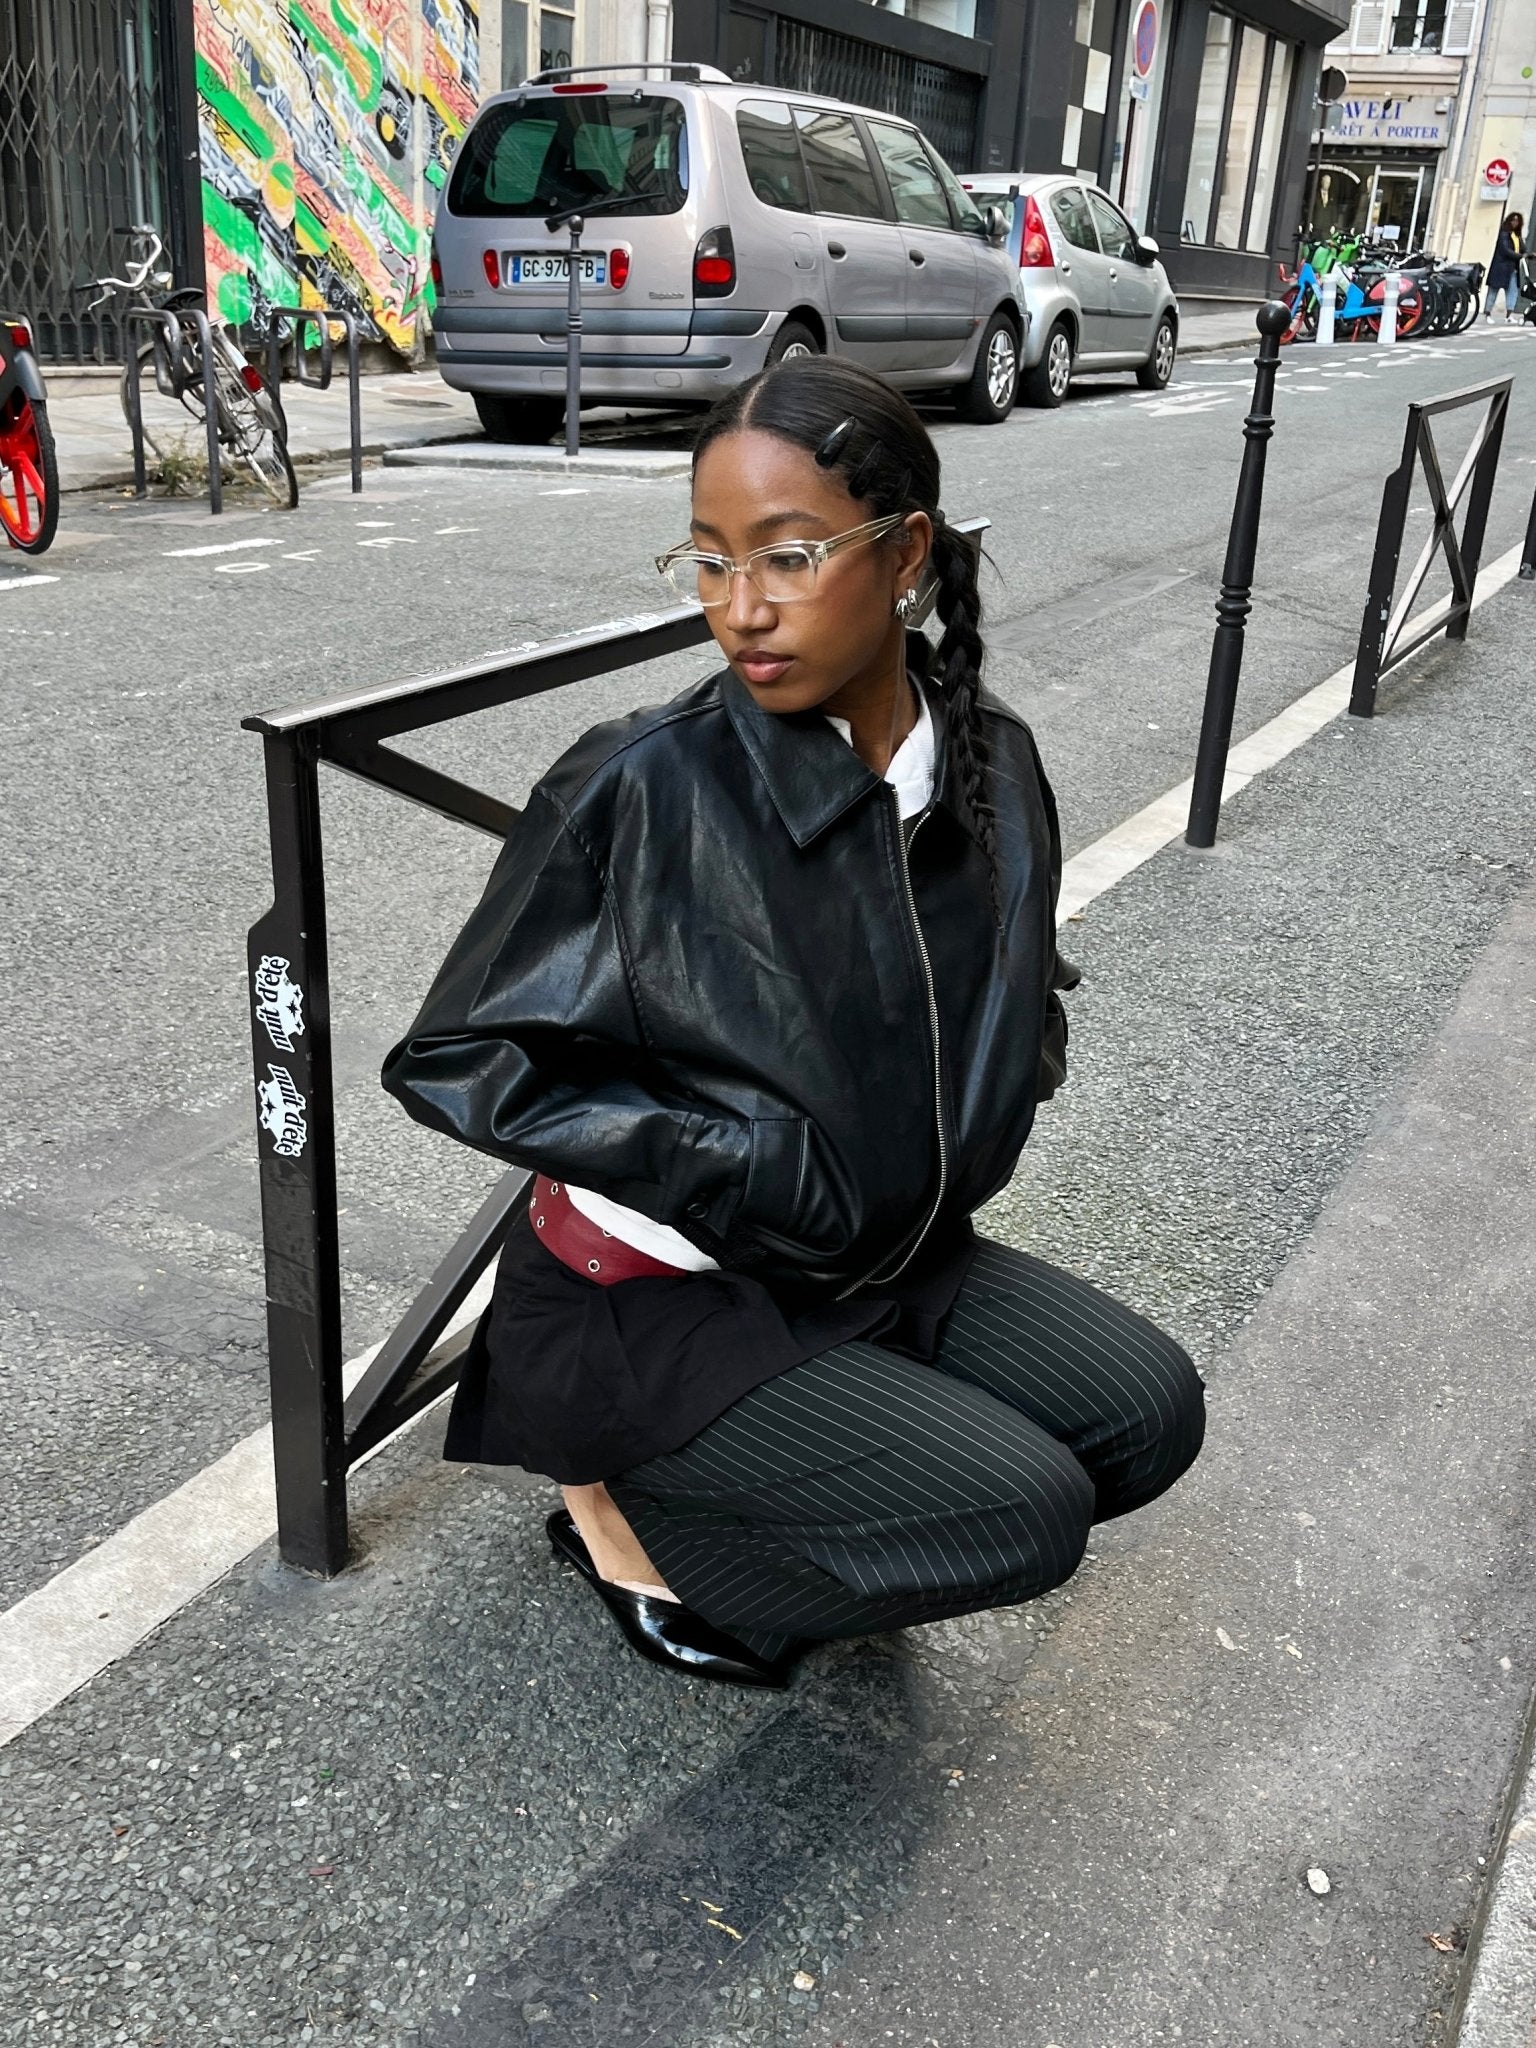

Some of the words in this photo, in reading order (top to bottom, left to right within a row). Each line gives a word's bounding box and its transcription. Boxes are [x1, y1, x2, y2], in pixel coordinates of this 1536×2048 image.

[1332, 121, 1365, 137] RÊT
[1387, 126, 1439, 139] PORTER
[258, 958, 287, 1003] d'été
[258, 1006, 291, 1049] nuit
[271, 1067, 304, 1109] nuit
[277, 1112, 304, 1154] d'été
